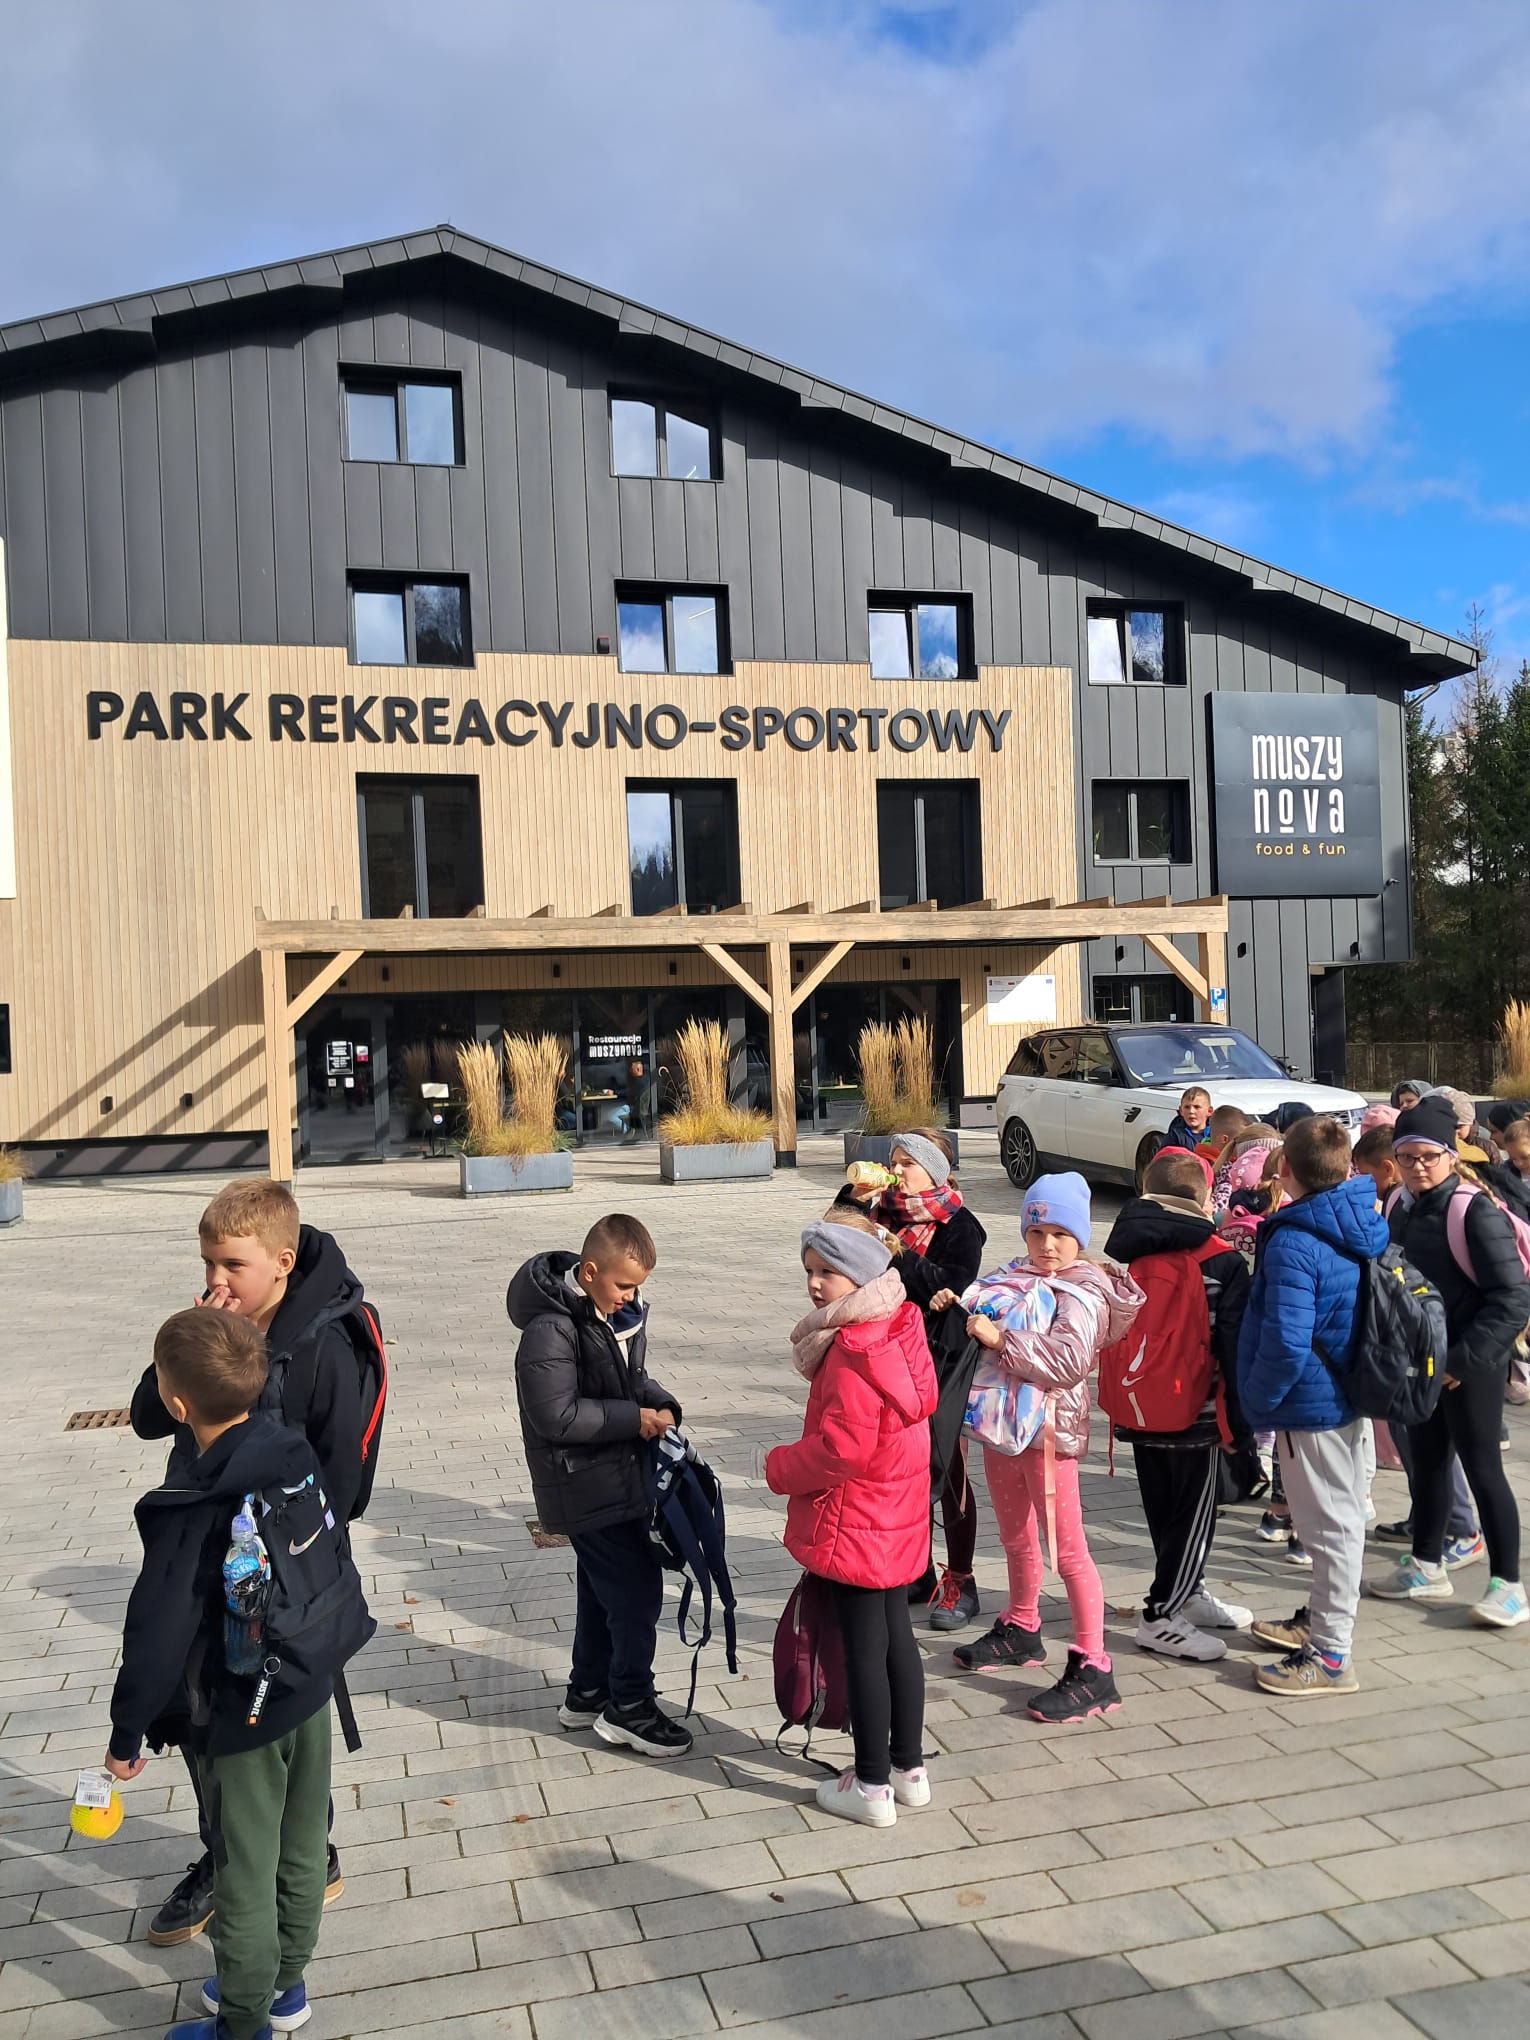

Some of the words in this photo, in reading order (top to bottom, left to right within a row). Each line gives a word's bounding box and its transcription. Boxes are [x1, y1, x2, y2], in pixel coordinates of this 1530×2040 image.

[87, 691, 253, 742] PARK
[268, 693, 1012, 752] REKREACYJNO-SPORTOWY
[1253, 787, 1345, 834] nova
[1255, 842, 1294, 856] food
[1302, 843, 1311, 855] &
[1318, 842, 1346, 855] fun
[1214, 988, 1222, 1000] P
[588, 1034, 642, 1044] Restauracja
[257, 1679, 269, 1697] JUST
[254, 1696, 263, 1708] DO
